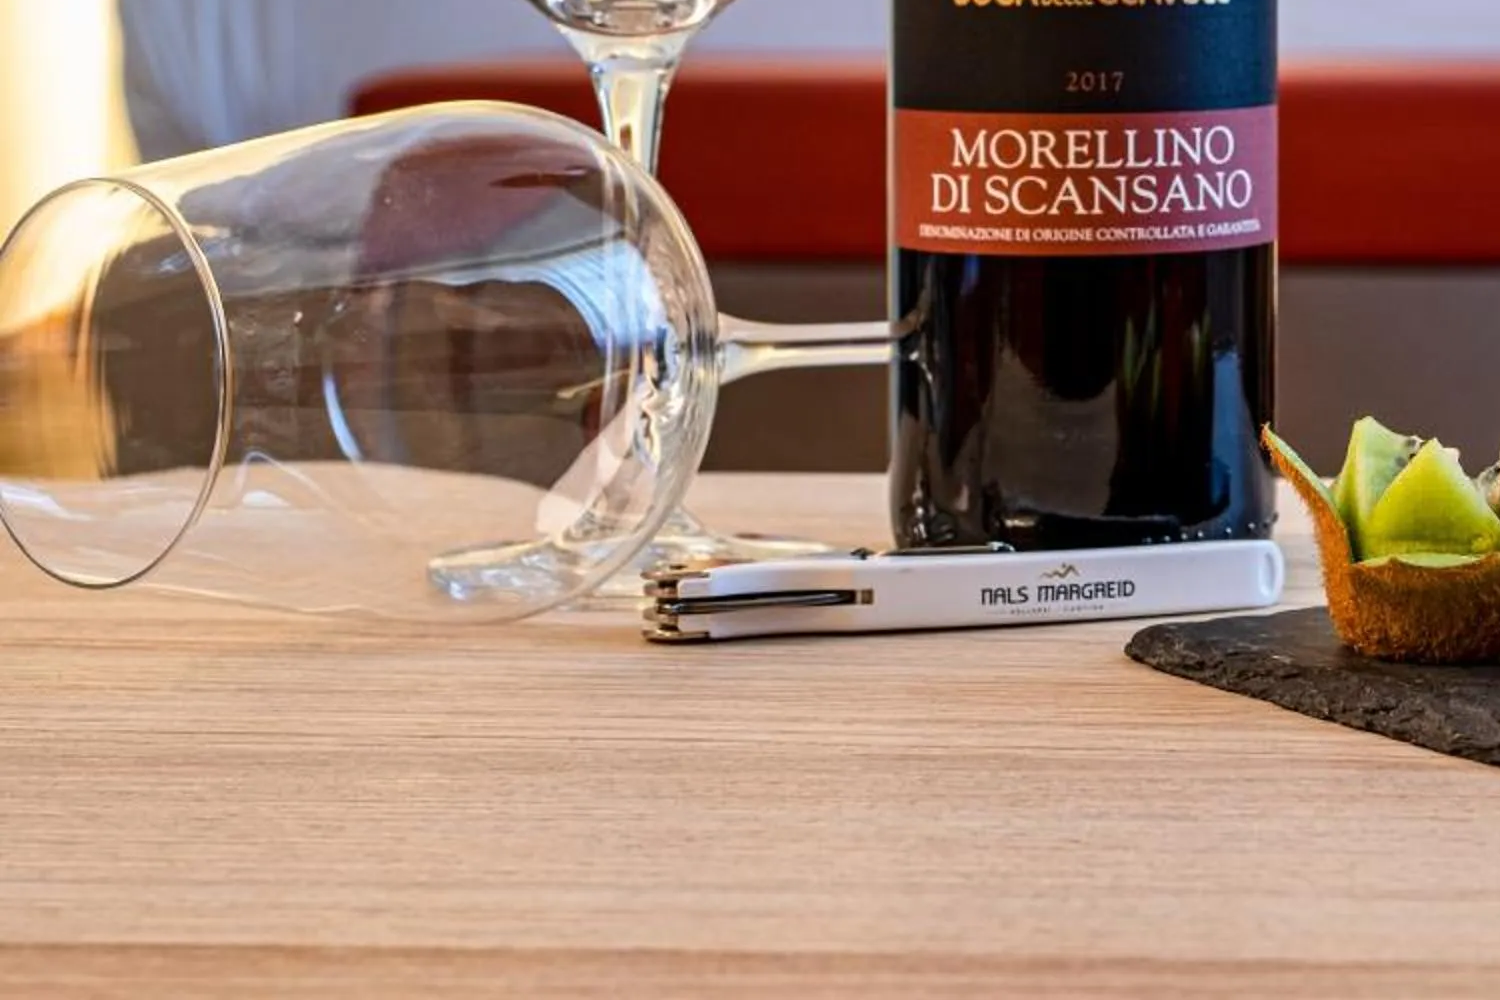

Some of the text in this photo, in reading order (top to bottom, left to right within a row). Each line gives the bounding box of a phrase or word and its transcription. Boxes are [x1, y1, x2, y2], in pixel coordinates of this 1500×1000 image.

[1065, 71, 1125, 92] 2017
[950, 125, 1235, 169] MORELLINO
[931, 169, 1252, 216] DI SCANSANO
[1015, 228, 1031, 242] DI
[1032, 228, 1093, 243] ORIGINE
[1096, 223, 1196, 241] CONTROLLATA
[981, 580, 1136, 605] NALS MARGREID
